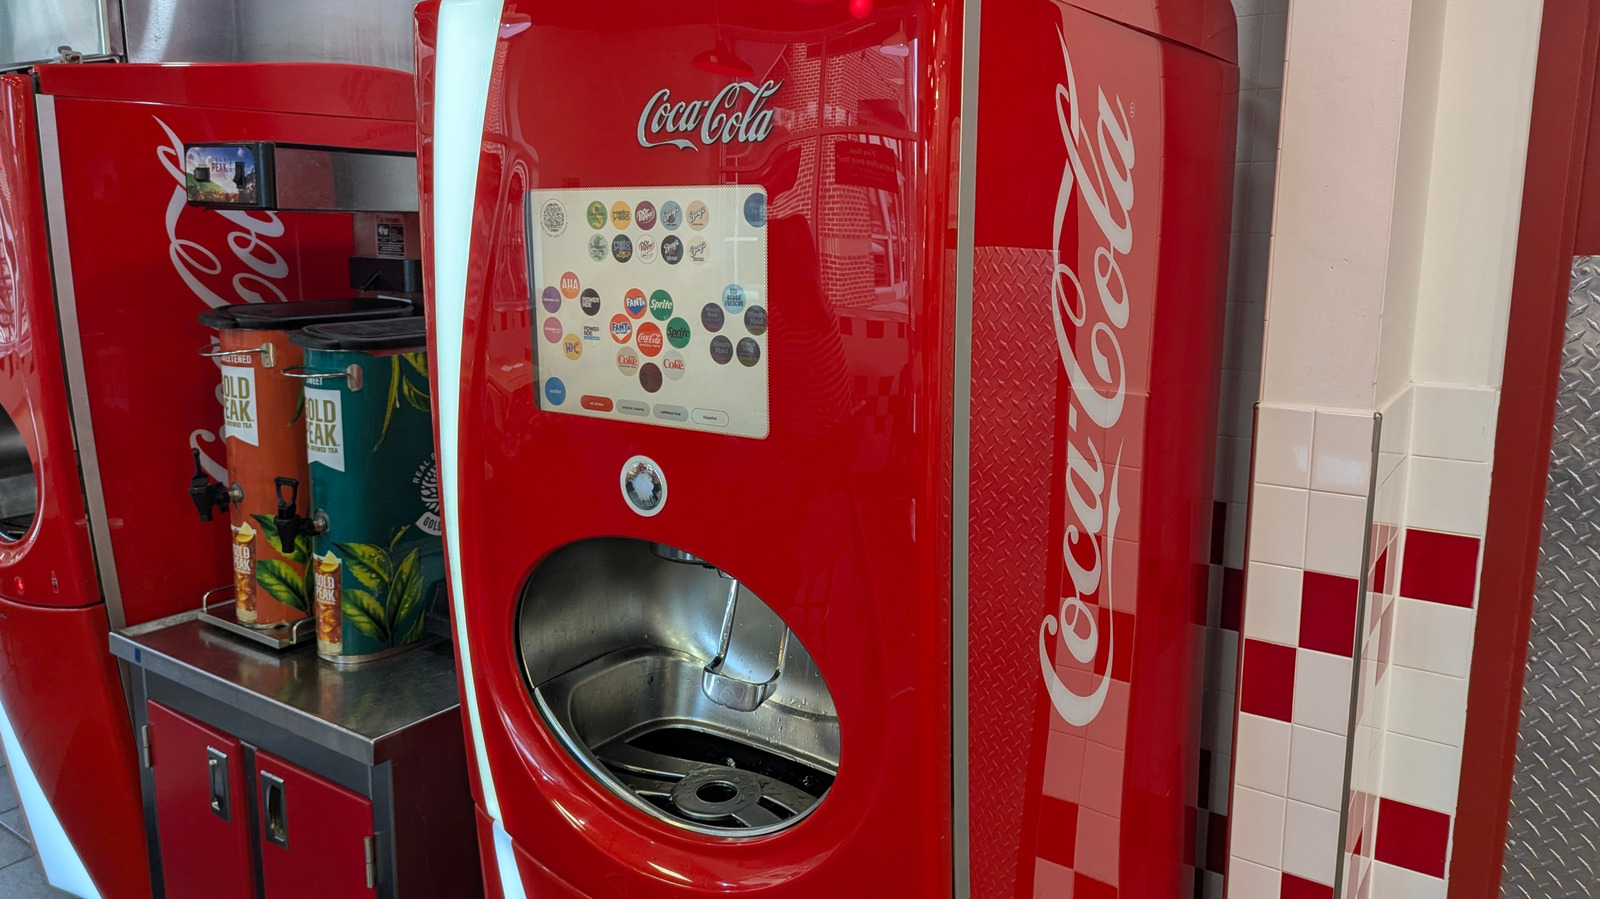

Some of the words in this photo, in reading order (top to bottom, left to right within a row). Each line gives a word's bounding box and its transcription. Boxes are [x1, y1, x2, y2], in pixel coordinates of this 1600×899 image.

[637, 79, 784, 152] Coca-Cola
[212, 163, 228, 173] PEAK
[562, 278, 579, 290] AHA
[626, 297, 646, 307] FANTA
[650, 299, 673, 310] Sprite
[612, 322, 631, 332] FANTA
[667, 327, 690, 337] Sprite
[638, 332, 661, 344] Coca-Cola
[618, 354, 638, 365] Coke
[663, 358, 684, 370] Coke
[1039, 22, 1134, 726] Coca-Cola
[223, 374, 250, 399] OLD
[225, 398, 252, 422] EAK
[412, 460, 431, 484] REAL
